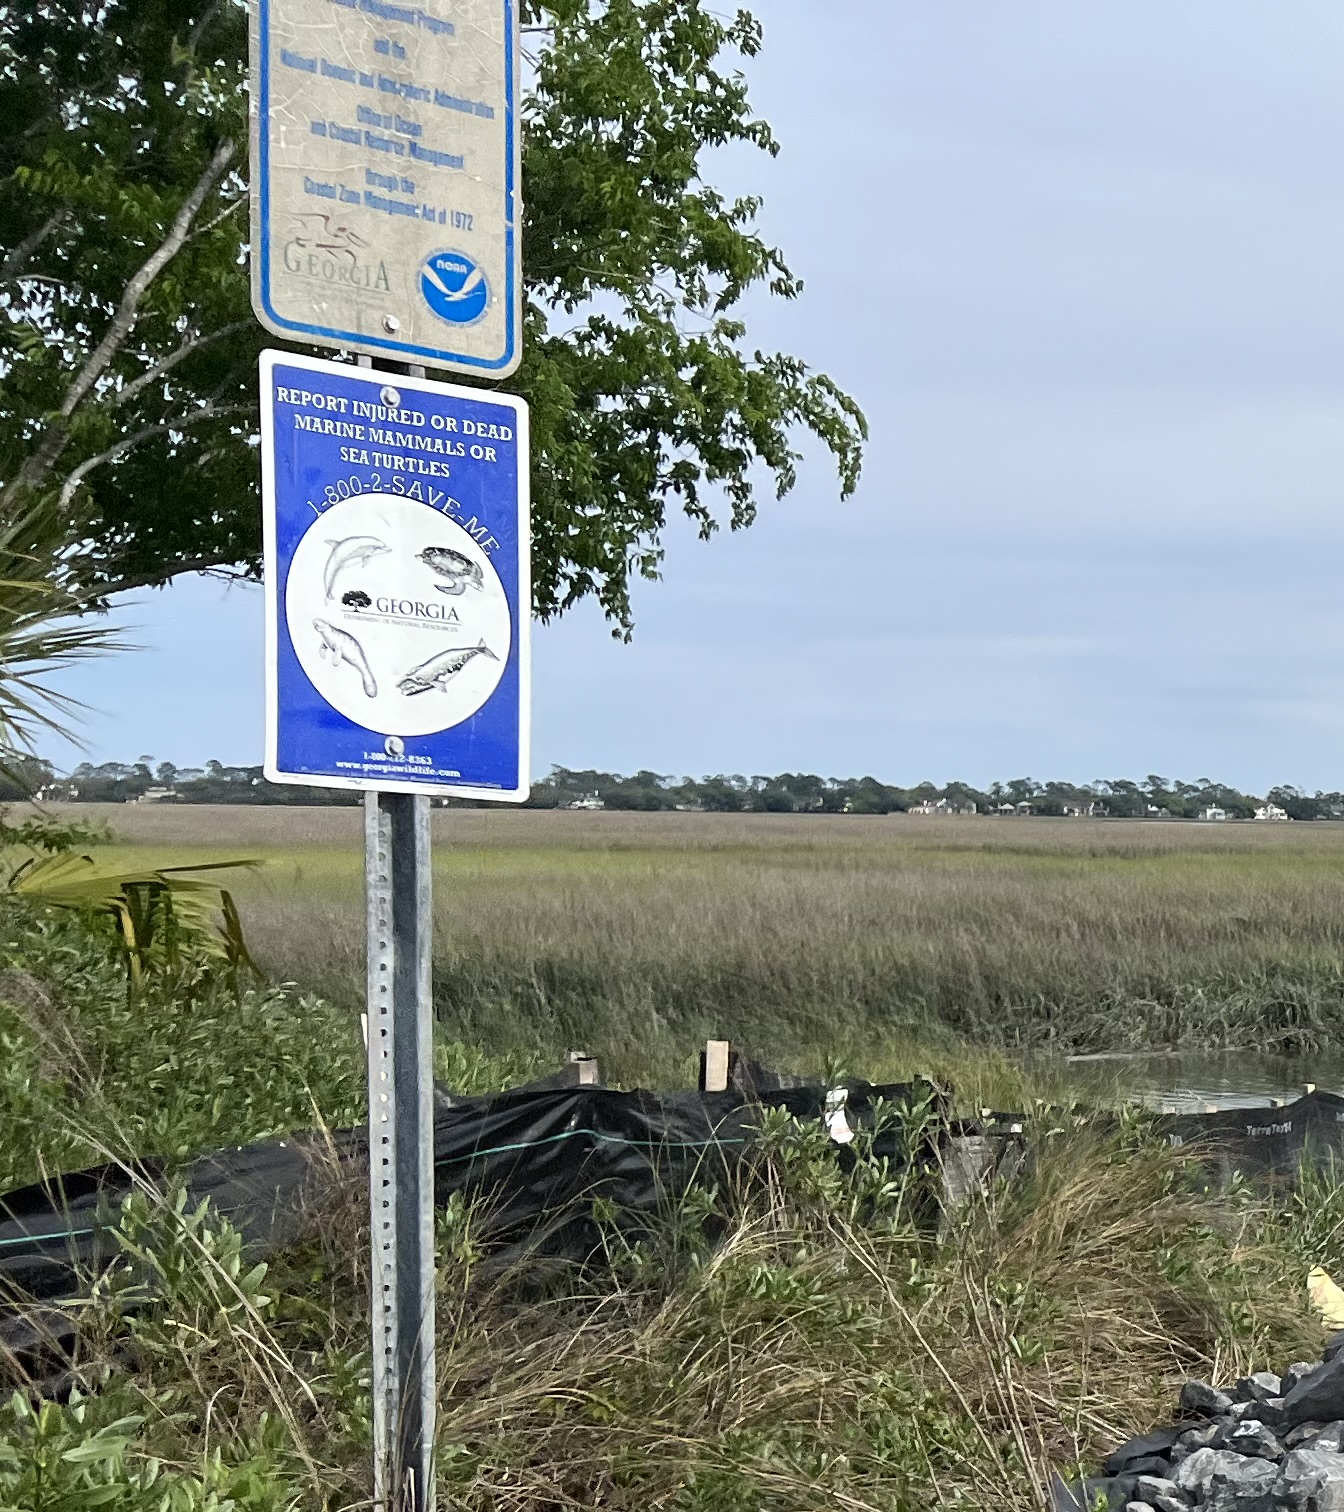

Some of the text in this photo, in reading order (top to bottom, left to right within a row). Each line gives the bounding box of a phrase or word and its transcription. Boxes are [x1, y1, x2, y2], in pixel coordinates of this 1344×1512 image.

[450, 209, 474, 232] 1972
[277, 386, 514, 442] REPORT INJURED OR DEAD
[294, 414, 498, 463] MARINE MAMMALS OR
[339, 446, 451, 478] SEA TURTLES
[376, 597, 460, 622] GEORGIA
[335, 760, 462, 778] www.georgiawildlife.com
